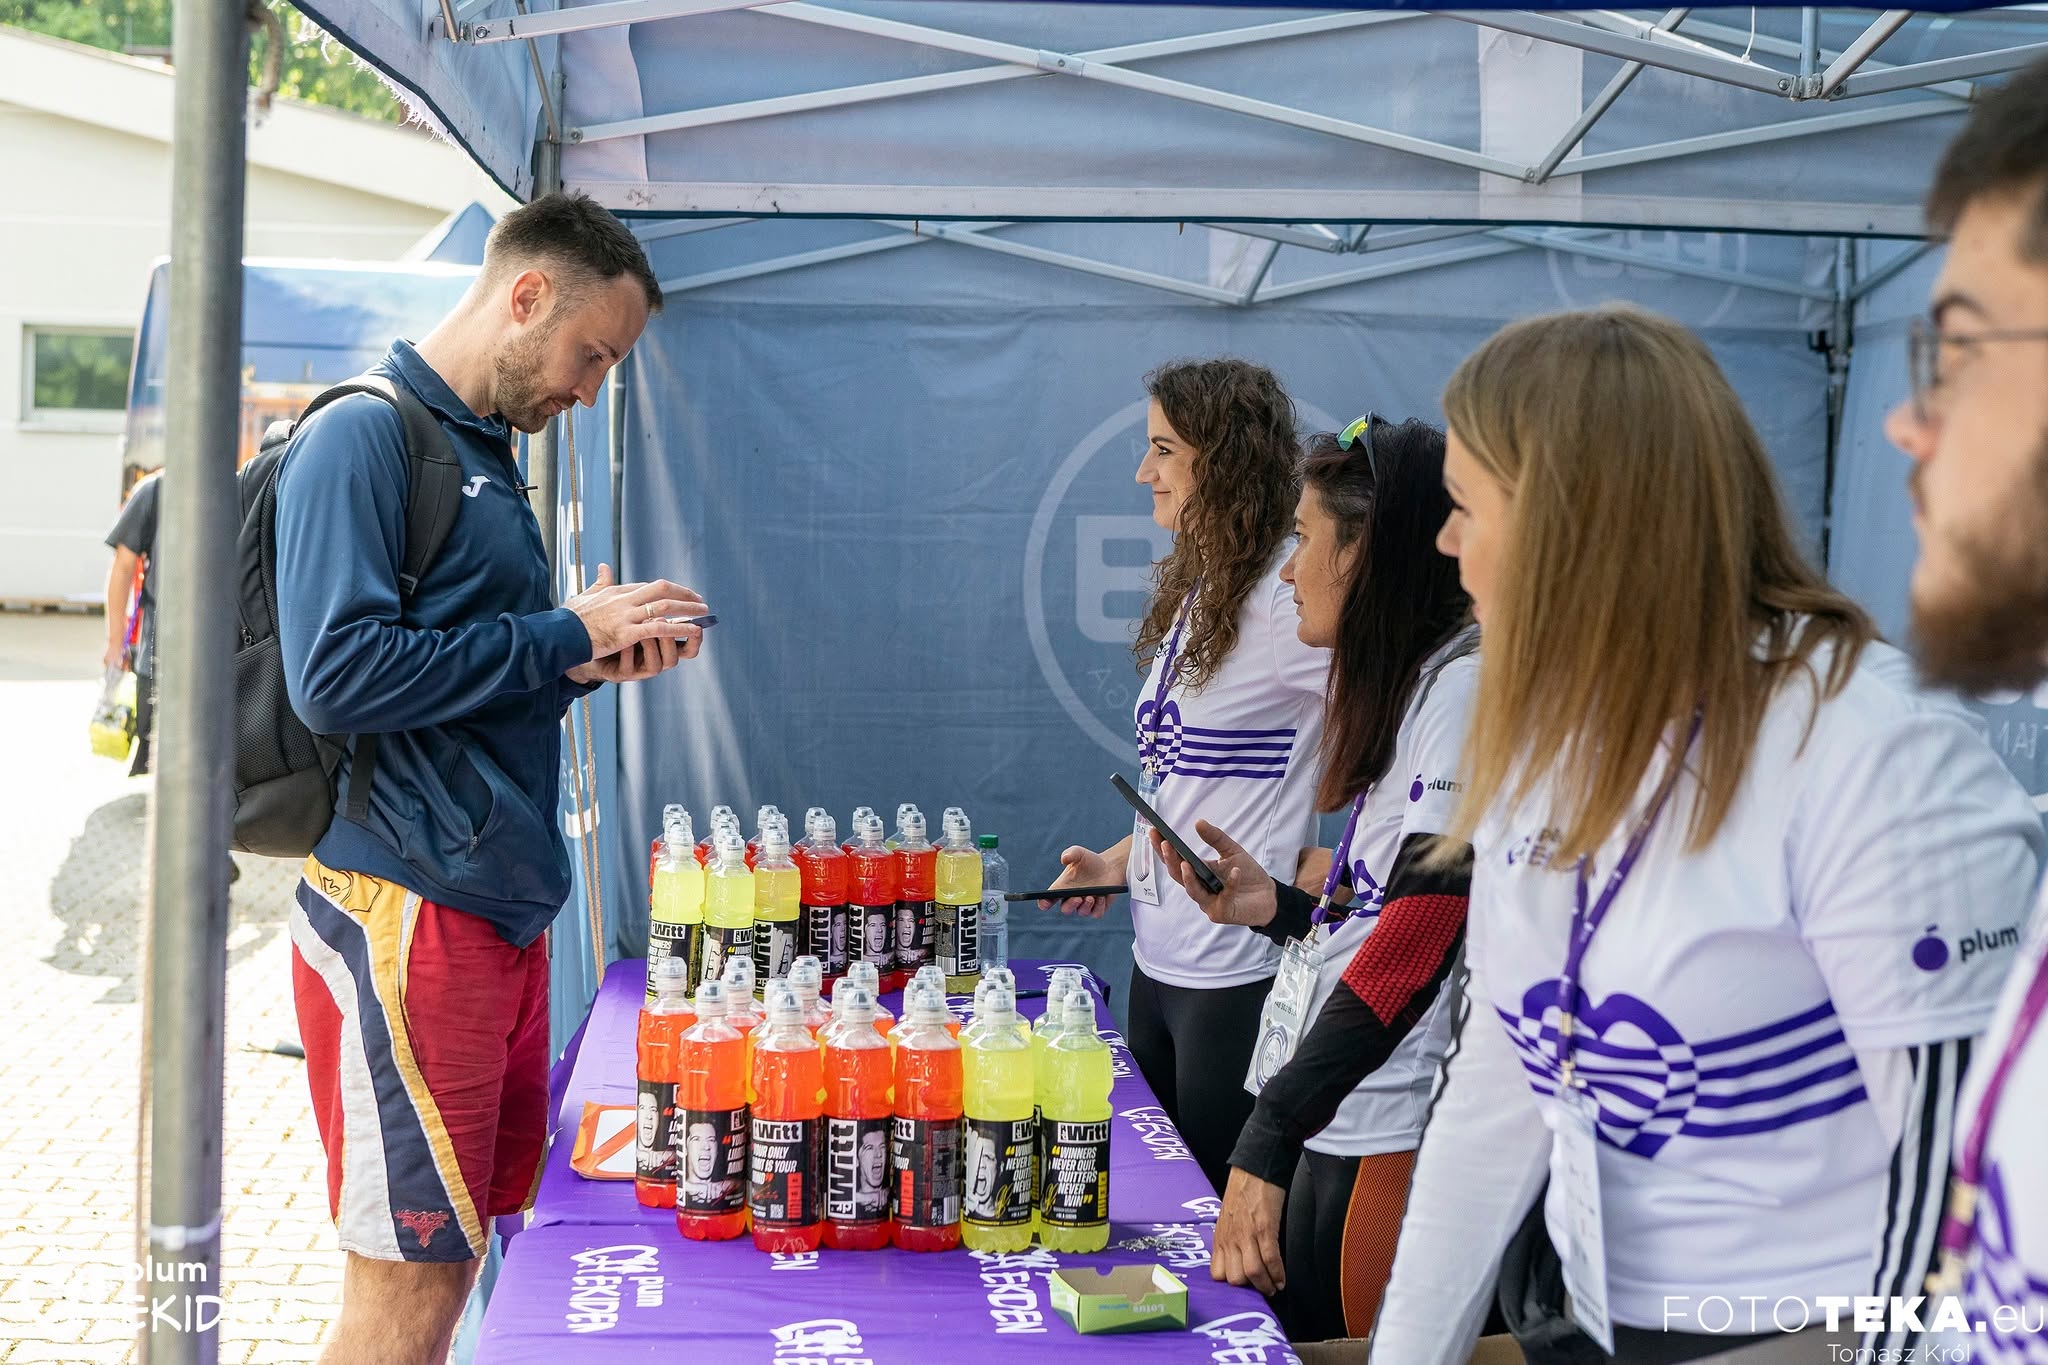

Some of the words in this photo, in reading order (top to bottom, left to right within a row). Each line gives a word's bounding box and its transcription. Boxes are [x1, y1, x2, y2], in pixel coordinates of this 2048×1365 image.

[654, 923, 684, 938] Witt
[960, 907, 977, 962] Witt
[1959, 926, 2018, 961] plum
[758, 1124, 799, 1141] Witt
[894, 1121, 911, 1138] itt
[1067, 1123, 1107, 1141] Witt
[768, 1145, 789, 1159] ONLY
[764, 1159, 774, 1172] IS
[774, 1160, 798, 1173] YOUR
[830, 1124, 854, 1202] Witt
[1051, 1158, 1077, 1171] NEVER
[1058, 1170, 1098, 1184] QUITTERS
[1057, 1182, 1086, 1195] NEVER
[565, 1275, 622, 1334] EKIDEN
[980, 1270, 1048, 1334] EKDEN
